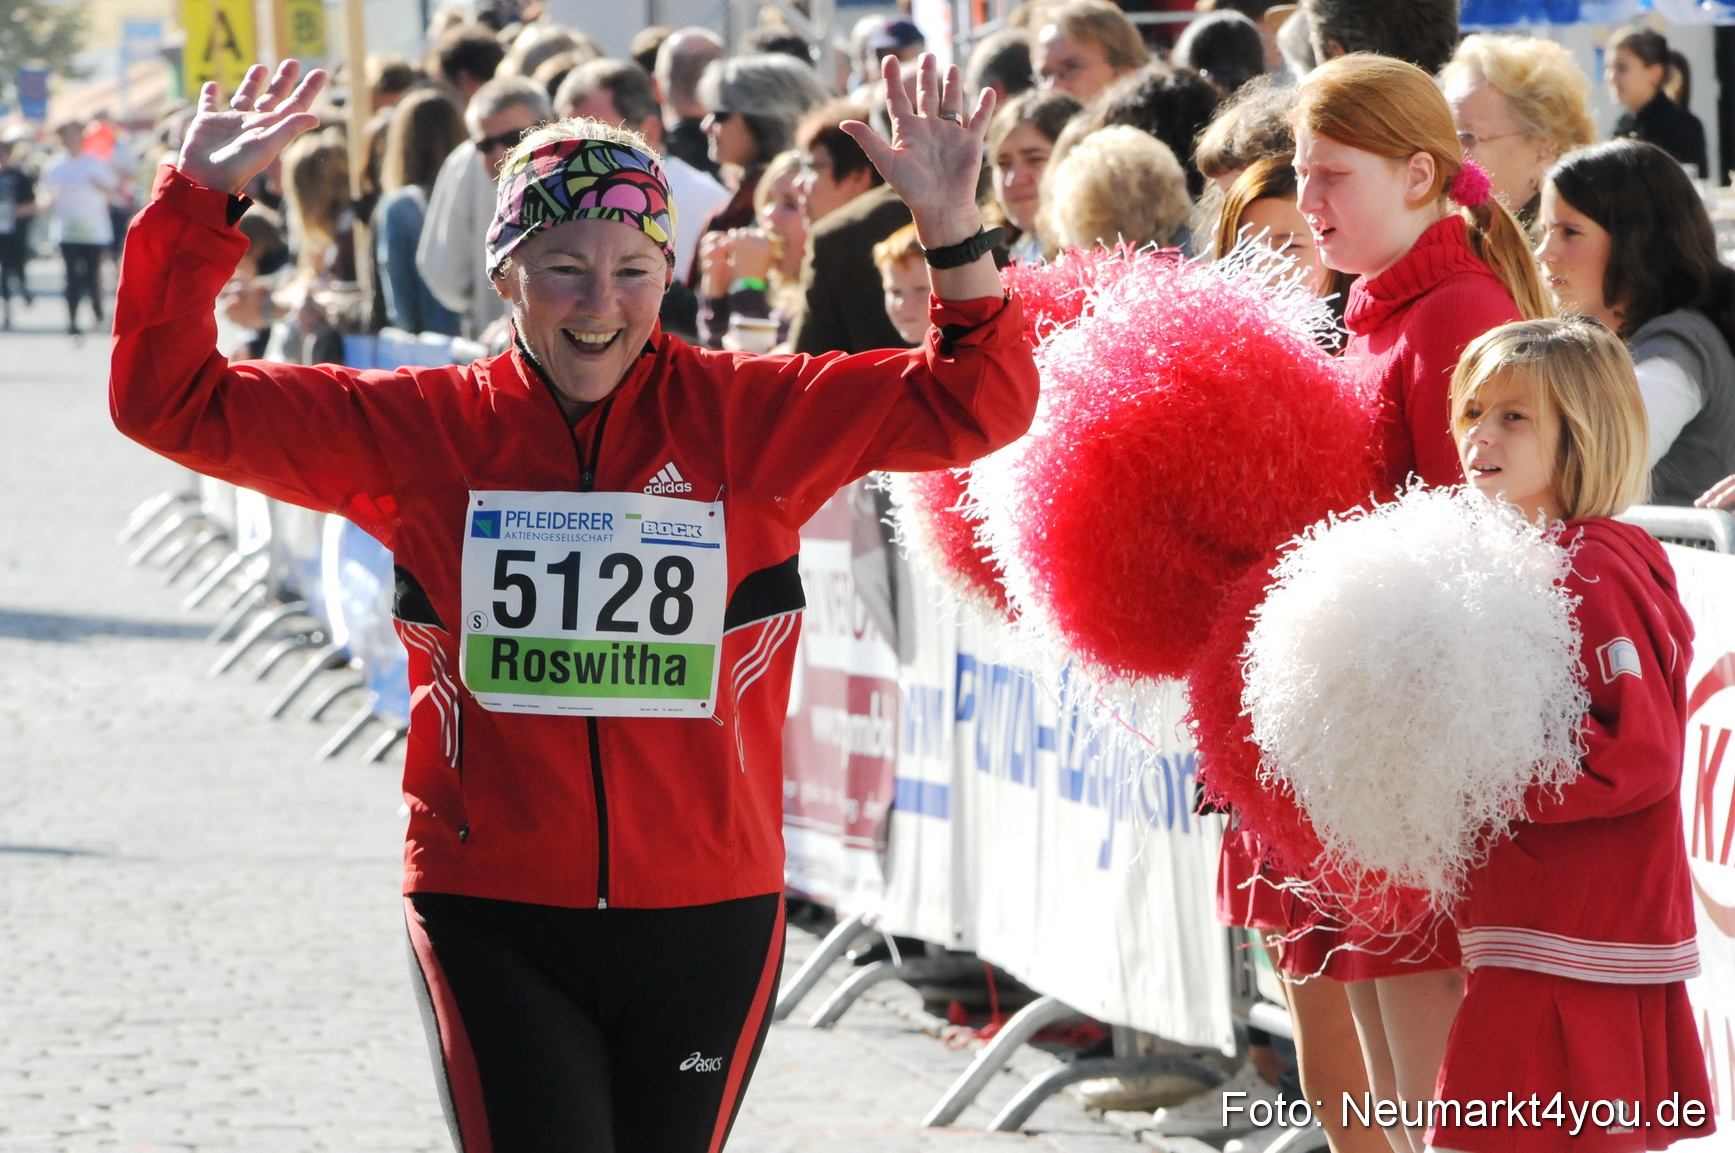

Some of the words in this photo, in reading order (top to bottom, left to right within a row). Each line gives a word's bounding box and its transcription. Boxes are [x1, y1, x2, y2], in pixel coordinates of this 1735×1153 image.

[203, 10, 243, 61] A
[643, 480, 692, 495] adidas
[505, 510, 614, 531] PFLEIDERER
[641, 520, 703, 538] BOCK
[504, 531, 613, 543] AKTIENGESELLSCHAFT
[492, 549, 695, 636] 5128
[473, 614, 482, 629] S
[491, 637, 687, 686] Roswitha
